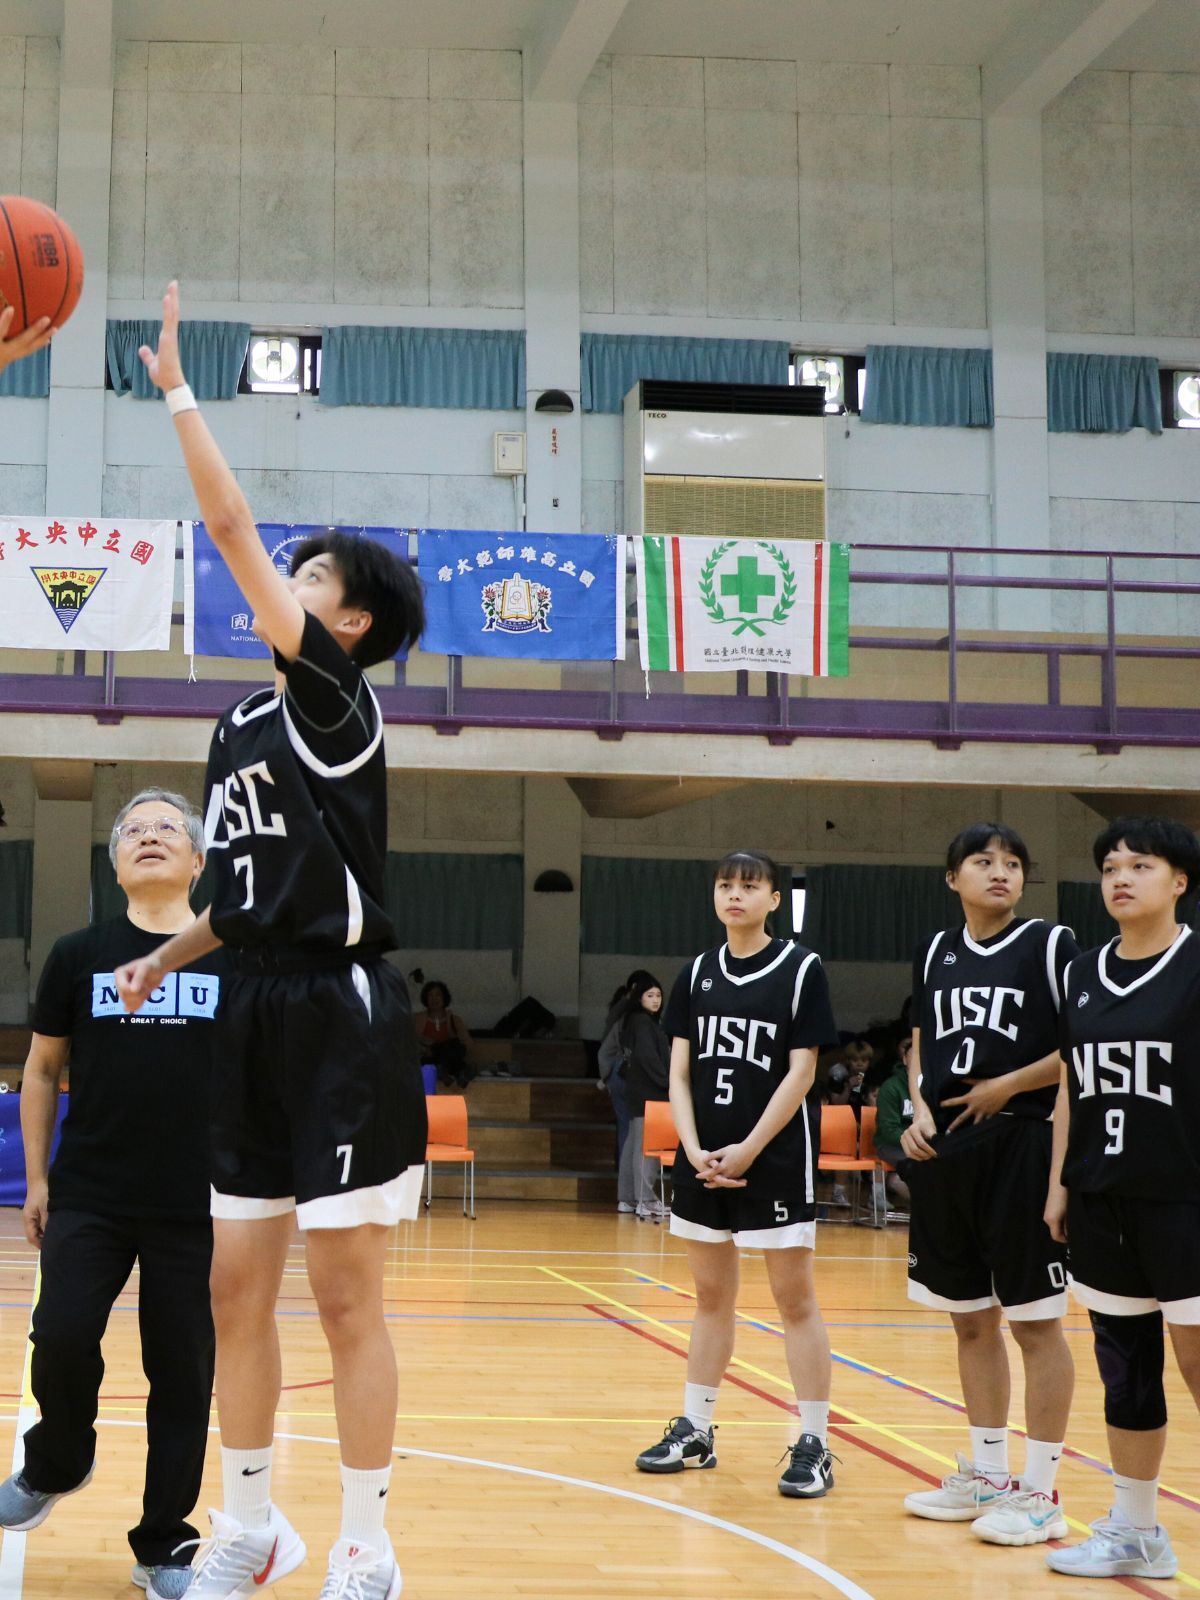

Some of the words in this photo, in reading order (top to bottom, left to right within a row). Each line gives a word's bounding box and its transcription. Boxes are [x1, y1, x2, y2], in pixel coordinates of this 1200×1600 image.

[203, 760, 288, 849] USC
[233, 854, 255, 910] 7
[933, 986, 1025, 1041] USC
[697, 1015, 778, 1072] USC
[950, 1037, 975, 1074] 0
[714, 1068, 735, 1105] 5
[1072, 1040, 1173, 1106] USC
[1104, 1108, 1125, 1155] 9
[336, 1144, 353, 1184] 7
[774, 1200, 789, 1222] 5
